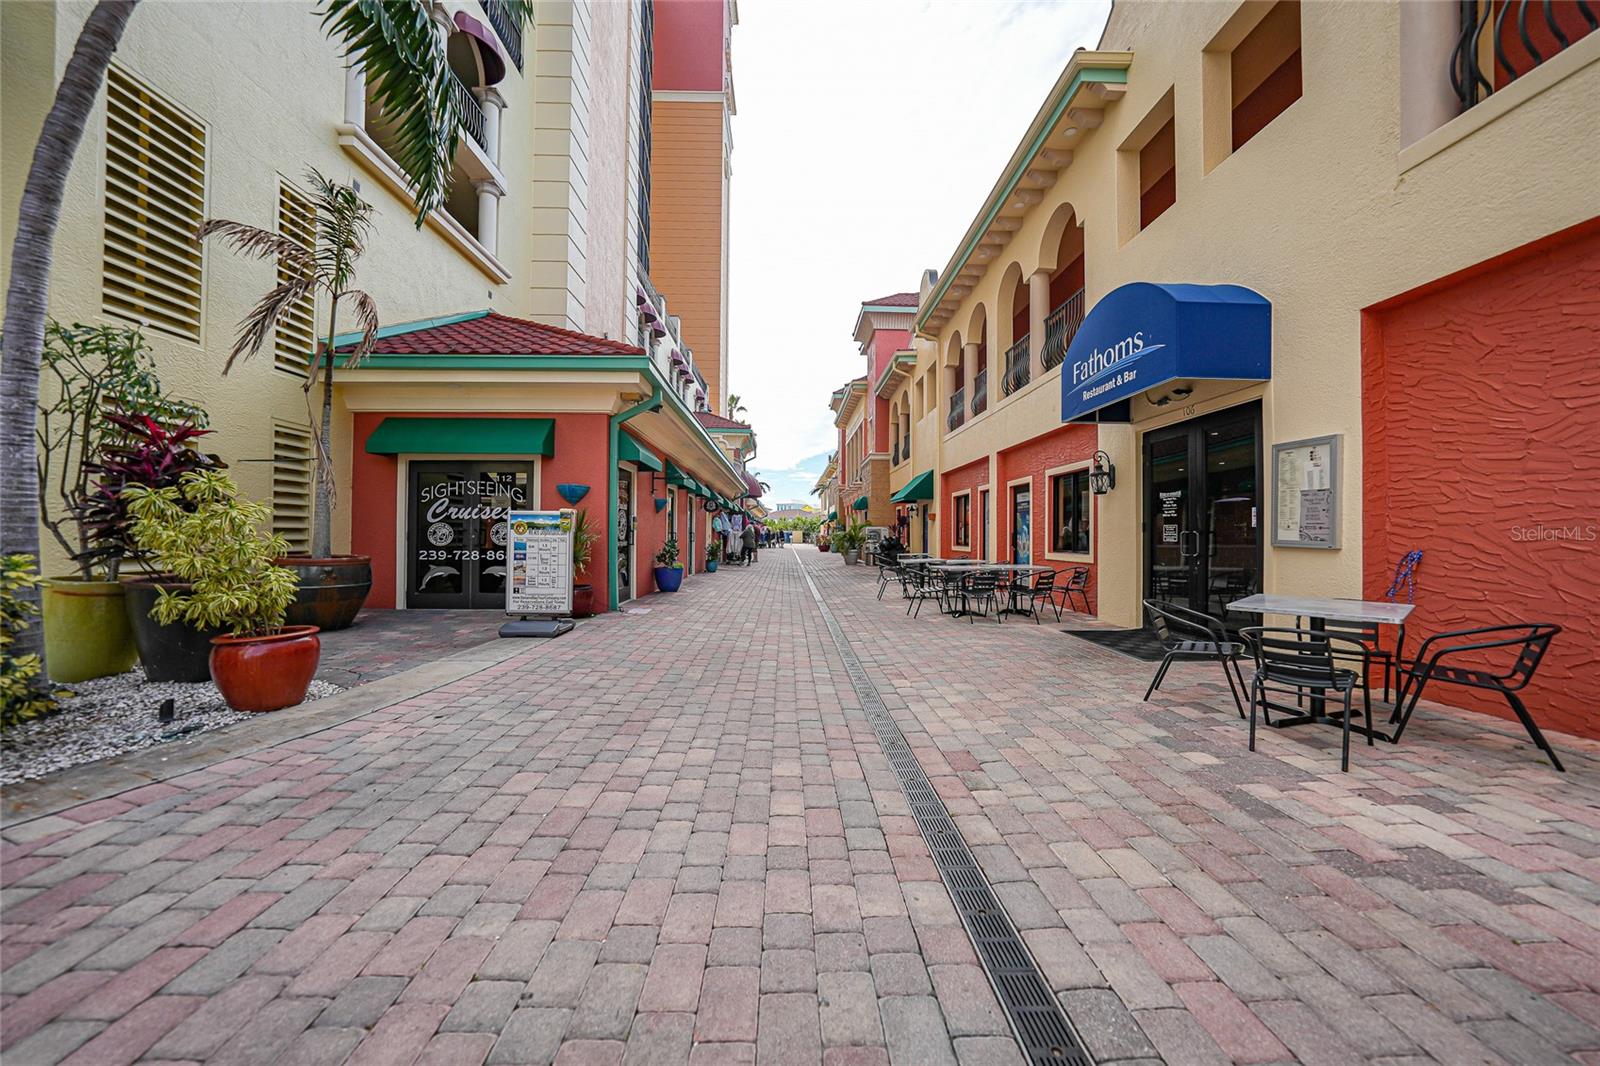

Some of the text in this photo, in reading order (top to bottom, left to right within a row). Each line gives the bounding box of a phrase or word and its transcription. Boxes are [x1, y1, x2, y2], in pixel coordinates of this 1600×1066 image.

[1073, 331, 1144, 385] Fathoms
[1082, 369, 1137, 401] Restaurant & Bar
[420, 480, 524, 503] SIGHTSEEING
[418, 550, 508, 561] 239-728-86
